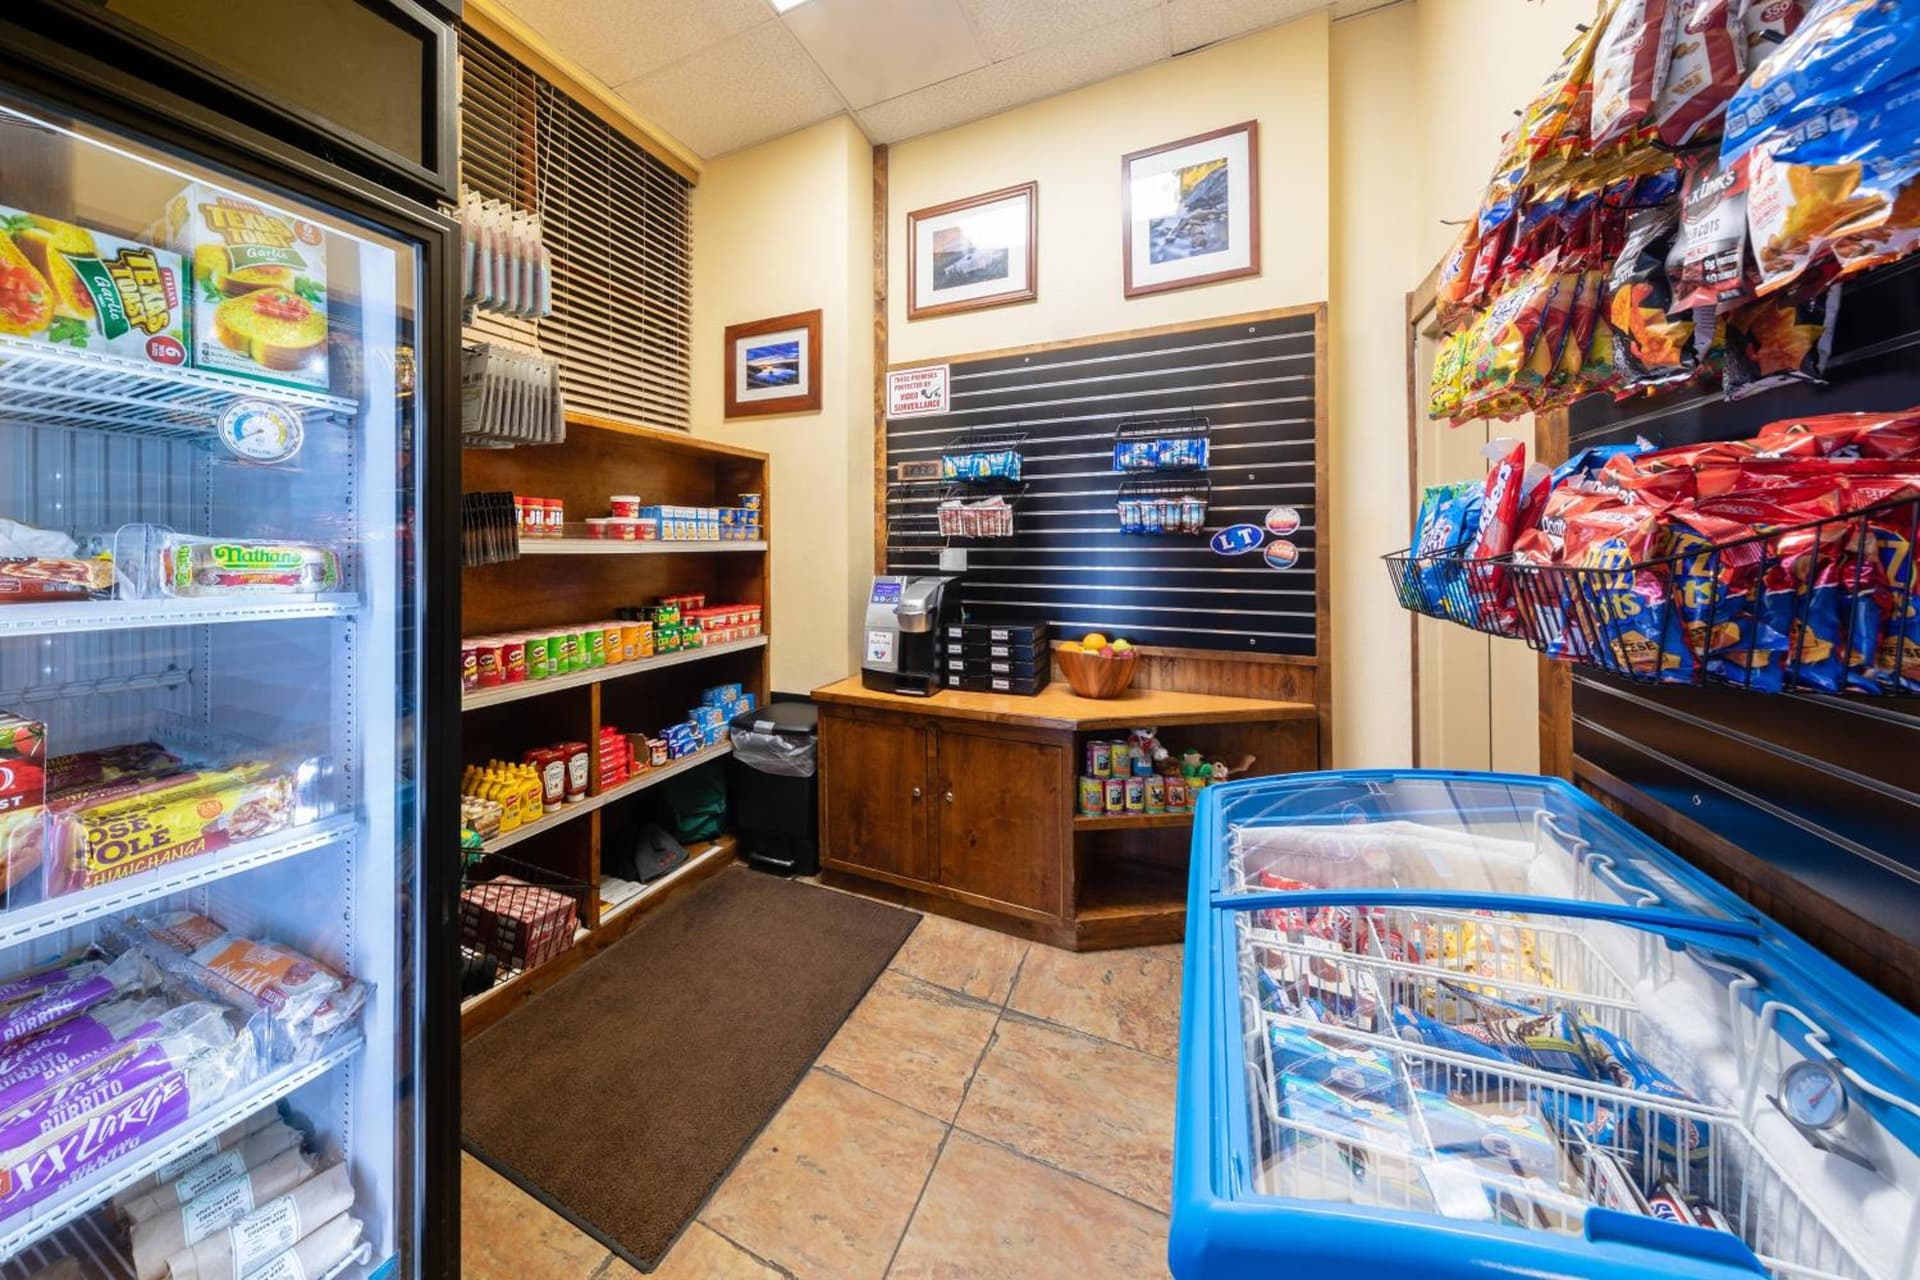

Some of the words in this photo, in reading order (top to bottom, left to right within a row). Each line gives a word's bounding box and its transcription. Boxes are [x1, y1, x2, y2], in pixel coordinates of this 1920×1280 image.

[94, 275, 121, 321] Garlic
[111, 265, 148, 326] TOAST
[125, 252, 169, 333] TEXAS
[894, 399, 940, 412] SURVEILLANCE
[1542, 516, 1566, 537] Dorit
[88, 817, 152, 846] OSE
[40, 1079, 124, 1134] BURRITO
